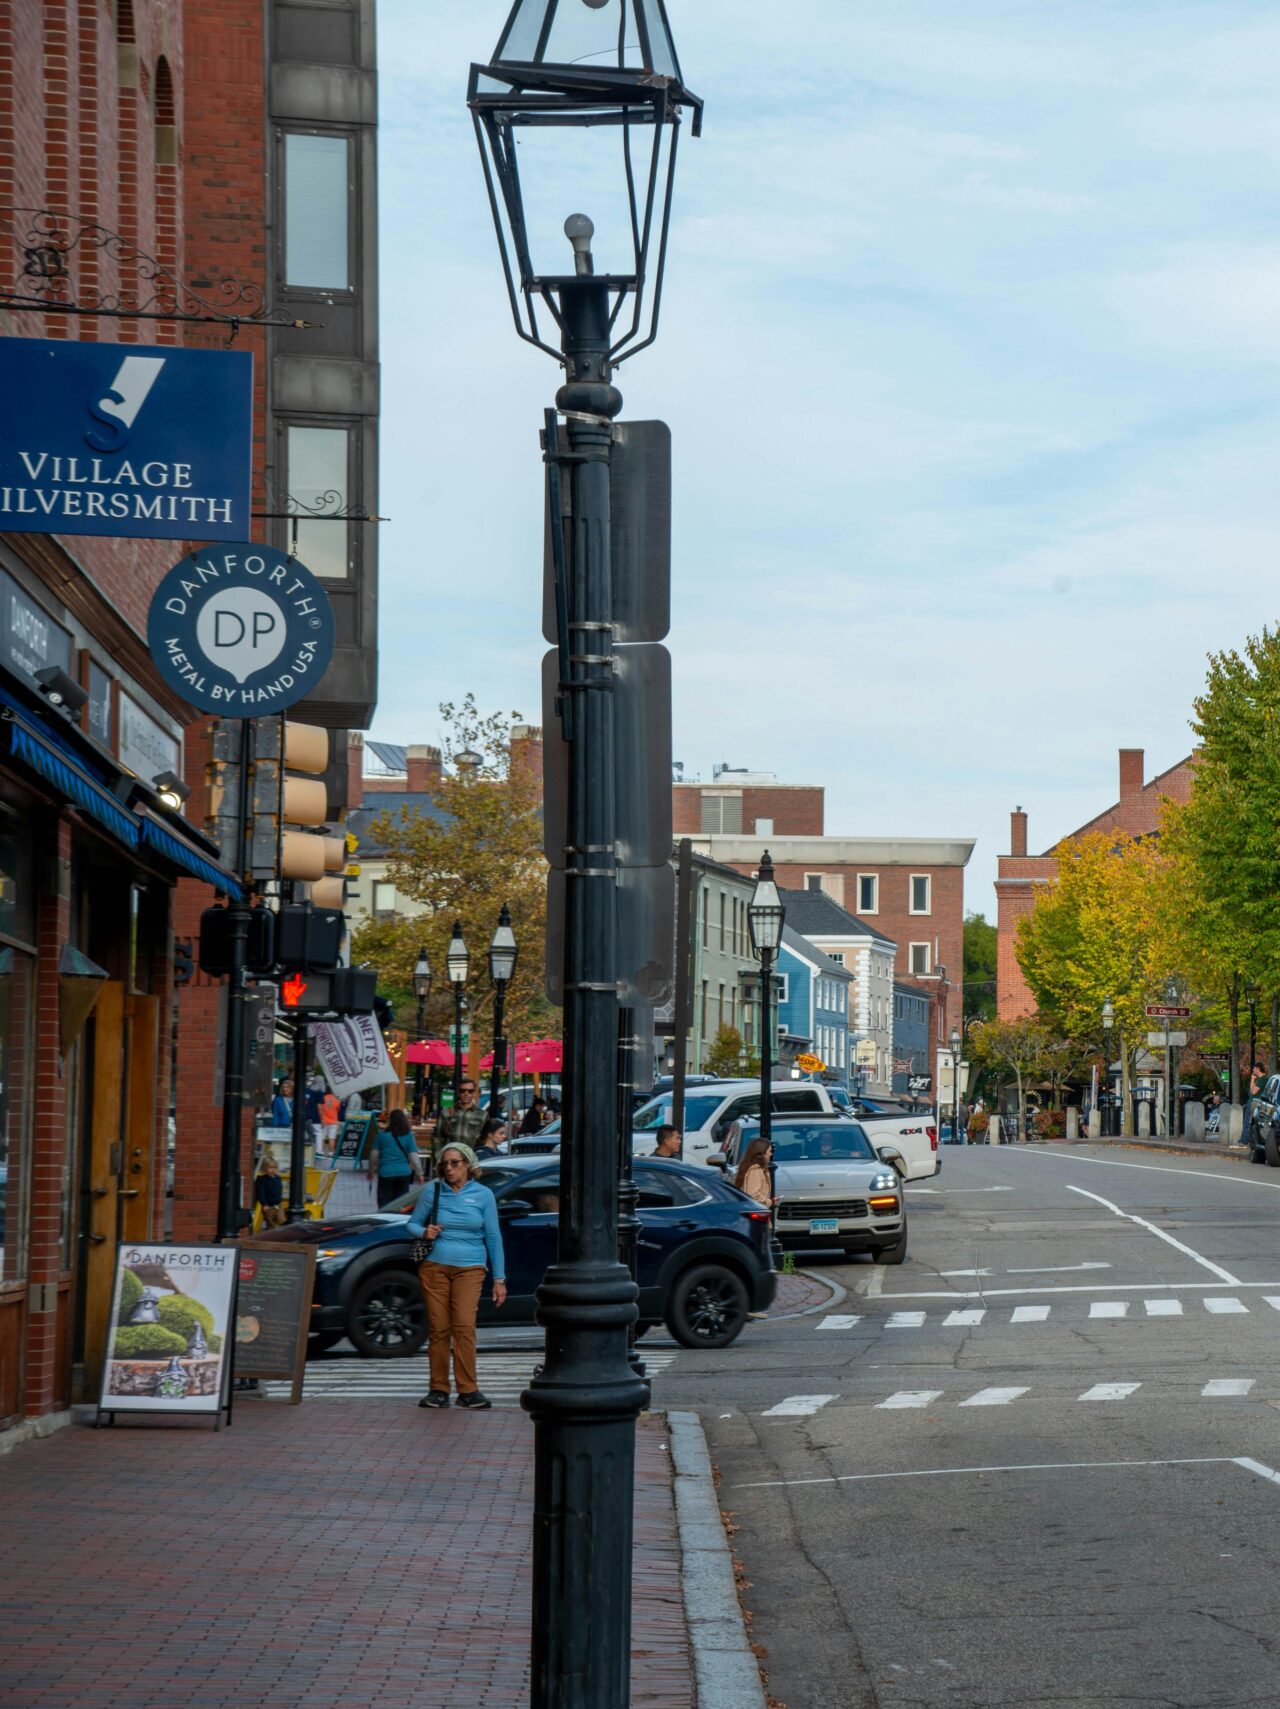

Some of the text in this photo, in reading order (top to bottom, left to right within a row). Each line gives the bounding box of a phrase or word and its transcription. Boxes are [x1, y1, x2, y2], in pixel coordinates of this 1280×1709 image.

[18, 451, 193, 489] VILLAGE
[1, 487, 233, 523] ILVERSMITH
[165, 554, 317, 616] DANFORTH
[214, 610, 276, 648] DP
[165, 637, 318, 704] METAL BY HAND USA
[327, 1054, 346, 1078] SHOP
[131, 1252, 226, 1266] DANFORTH
